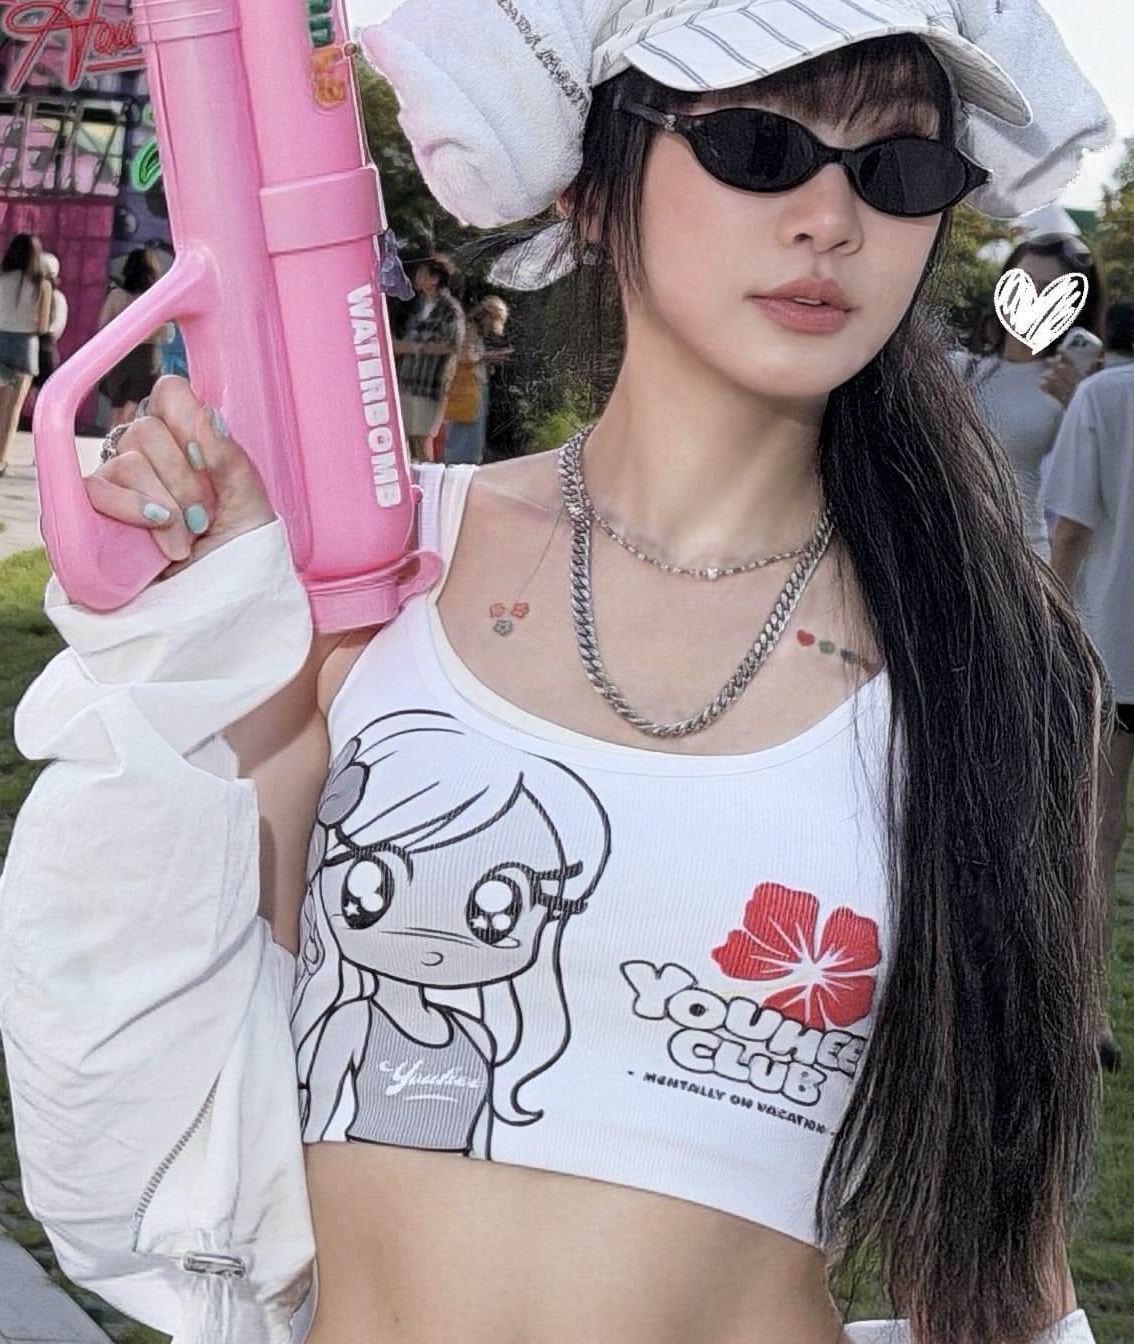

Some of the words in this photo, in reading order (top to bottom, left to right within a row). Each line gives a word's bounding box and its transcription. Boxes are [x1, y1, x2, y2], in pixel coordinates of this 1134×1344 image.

[347, 282, 402, 508] WATERBOMB
[642, 1070, 727, 1102] MENTALLY
[729, 1093, 754, 1109] ON
[756, 1101, 827, 1135] VACATION
[666, 1027, 828, 1107] CLUB
